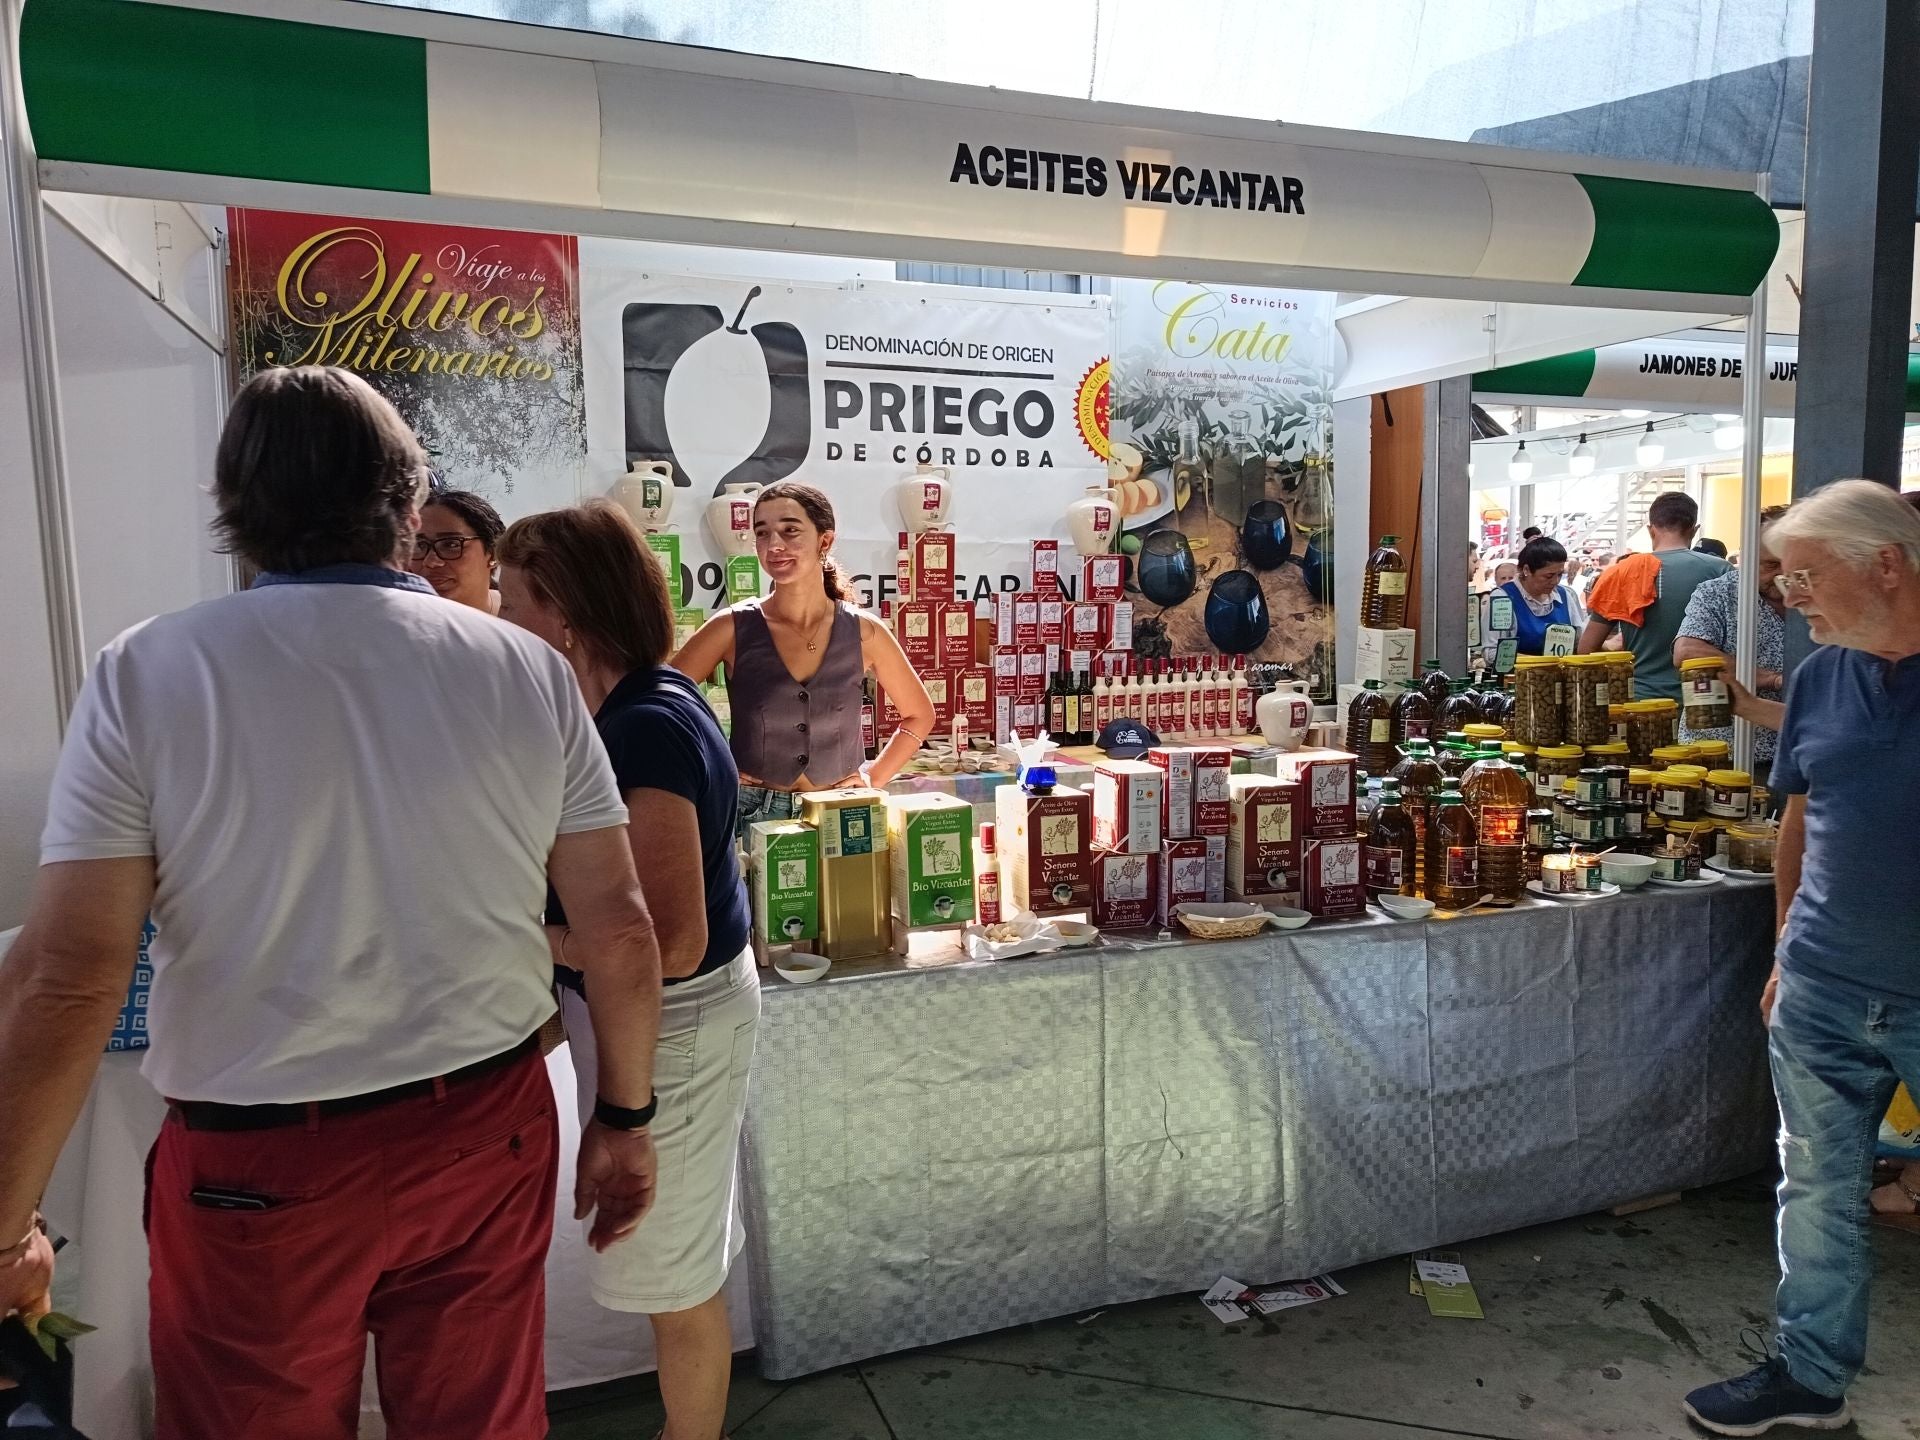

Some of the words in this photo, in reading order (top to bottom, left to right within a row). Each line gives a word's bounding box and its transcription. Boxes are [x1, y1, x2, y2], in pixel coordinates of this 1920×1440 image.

[949, 142, 1108, 198] ACEITES
[1116, 159, 1305, 215] VIZCANTAR
[277, 226, 545, 339] Olivos
[437, 243, 513, 291] Viaje
[517, 272, 526, 281] a
[529, 269, 546, 283] los
[1230, 293, 1299, 310] Servicios
[1152, 280, 1294, 364] Cata
[265, 312, 554, 381] Milenarios
[825, 333, 963, 359] DENOMINACIÓN
[967, 342, 989, 361] DE
[992, 344, 1054, 364] ORIGEN
[1146, 367, 1176, 379] Paisajes
[1177, 369, 1188, 379] de
[1189, 370, 1212, 379] Aroma
[1219, 371, 1238, 381] sabor
[1639, 353, 1717, 377] JAMONES
[1720, 358, 1742, 379] DE
[1769, 361, 1798, 382] JUR
[824, 379, 1055, 438] PRIEGO
[826, 442, 867, 462] DE
[892, 441, 1054, 468] CÓRDOBA
[1250, 662, 1294, 672] aromas
[912, 881, 929, 892] Bio
